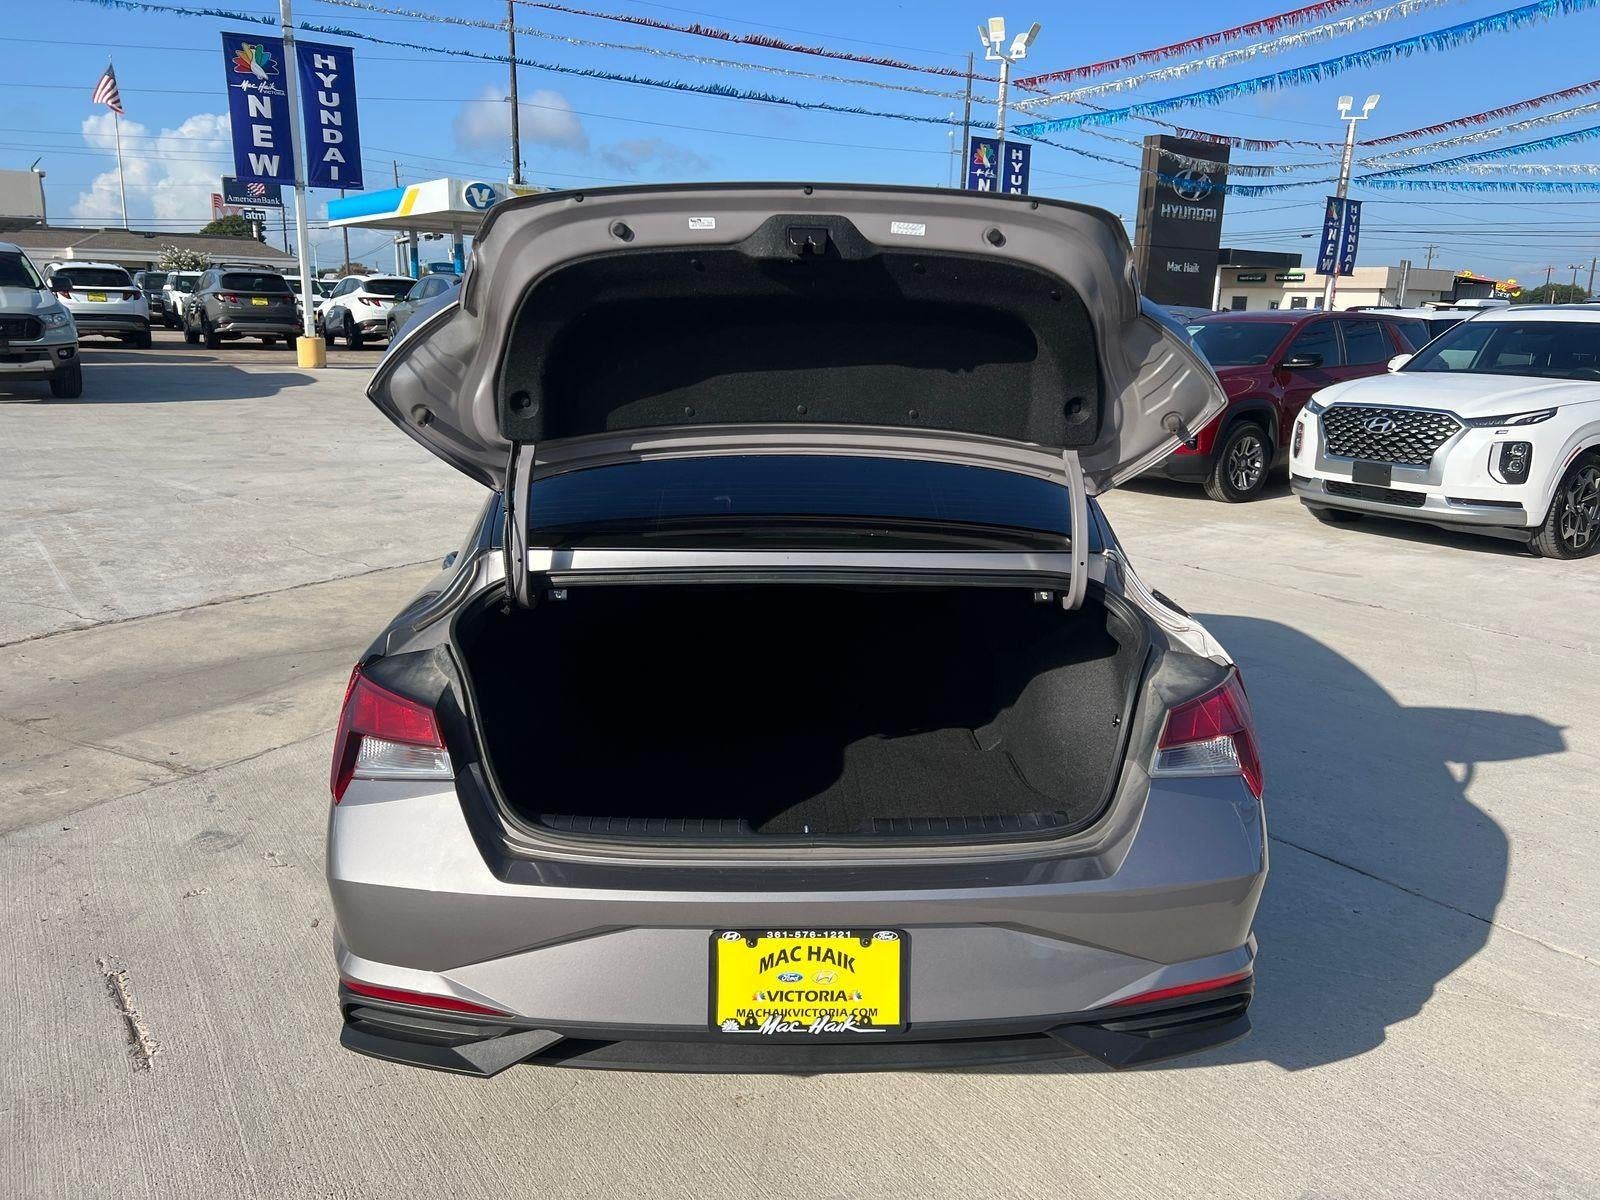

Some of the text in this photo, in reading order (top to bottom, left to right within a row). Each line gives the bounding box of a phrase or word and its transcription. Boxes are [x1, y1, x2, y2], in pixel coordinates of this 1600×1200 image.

[230, 79, 284, 93] Mac Haik
[313, 53, 346, 181] HYUNDAI
[247, 94, 280, 177] NEW
[1010, 149, 1023, 194] HYUN
[227, 194, 280, 205] AmericanBank
[245, 211, 265, 220] atm
[1161, 203, 1217, 222] HYUNDAI
[1344, 204, 1358, 272] HYUNDAI
[1321, 228, 1338, 271] NEW
[1166, 261, 1200, 273] Mac Haik
[766, 930, 851, 939] 361-576-1221
[759, 945, 856, 974] MAC HAIK
[767, 990, 848, 1002] VICTORIA
[741, 1015, 886, 1035] Mac Haik
